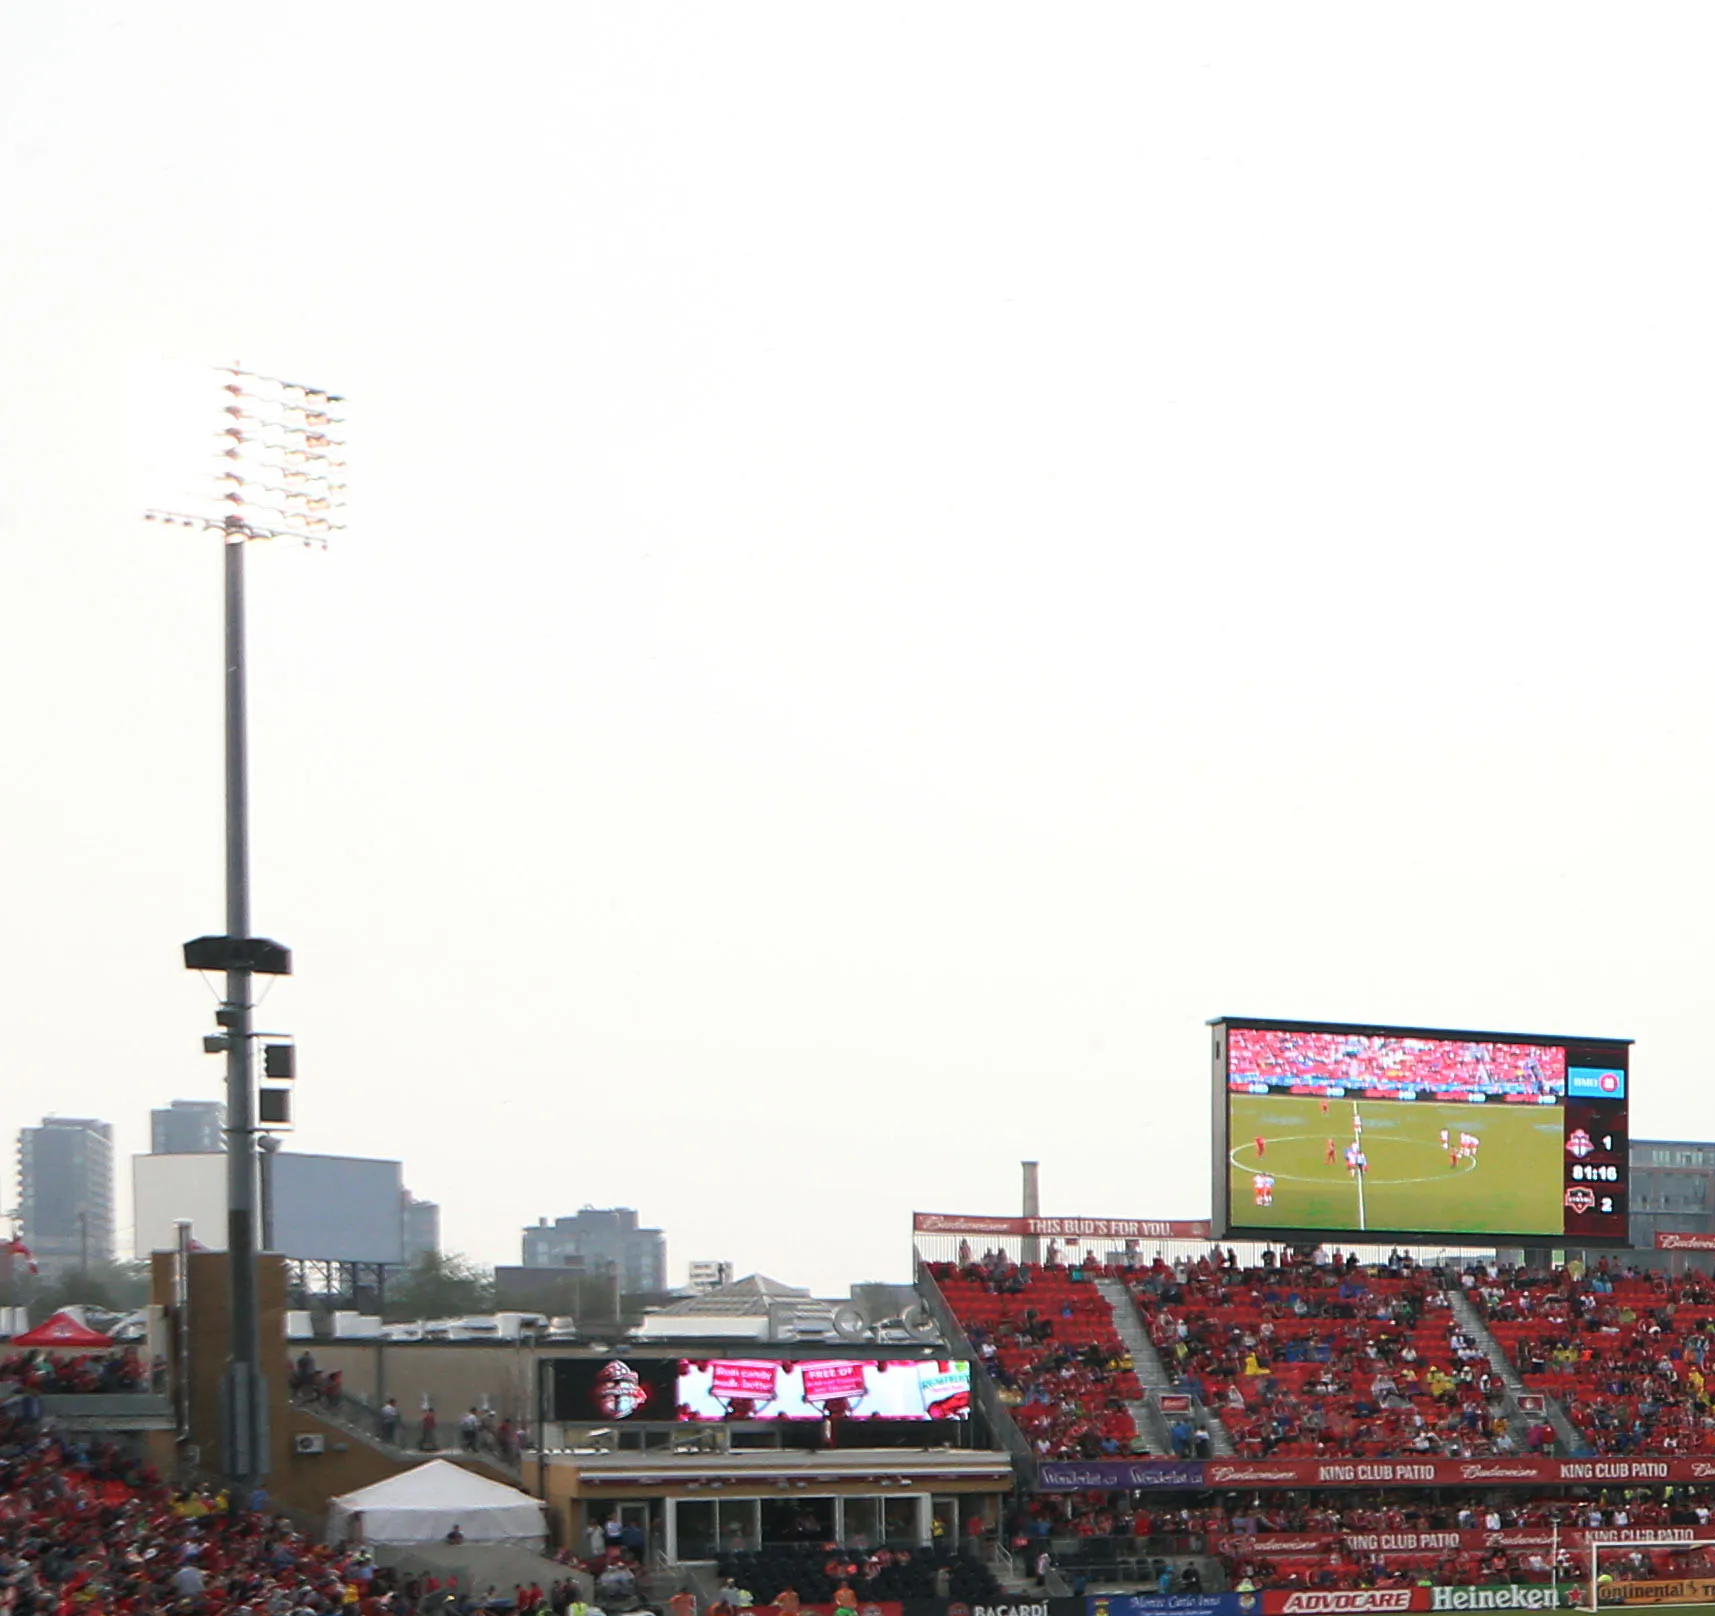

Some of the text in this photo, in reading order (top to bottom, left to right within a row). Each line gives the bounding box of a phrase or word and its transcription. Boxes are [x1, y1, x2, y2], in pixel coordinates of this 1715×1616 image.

[1602, 1135, 1612, 1150] 1
[1601, 1197, 1612, 1212] 2
[920, 1215, 1011, 1232] Budweiser
[1028, 1219, 1062, 1234] THIS
[1065, 1220, 1107, 1234] BUD'S
[1111, 1221, 1139, 1235] FOR
[1210, 1465, 1434, 1481] Budweiser KING CLUB PATIO
[1459, 1463, 1668, 1479] Budweiser KING CLUB PATIO
[1381, 1535, 1417, 1550] CLUB
[1420, 1534, 1460, 1549] PATIO
[1657, 1529, 1694, 1541] PATIO
[1284, 1590, 1411, 1613] ADVOCARE
[1432, 1584, 1560, 1610] Heineken
